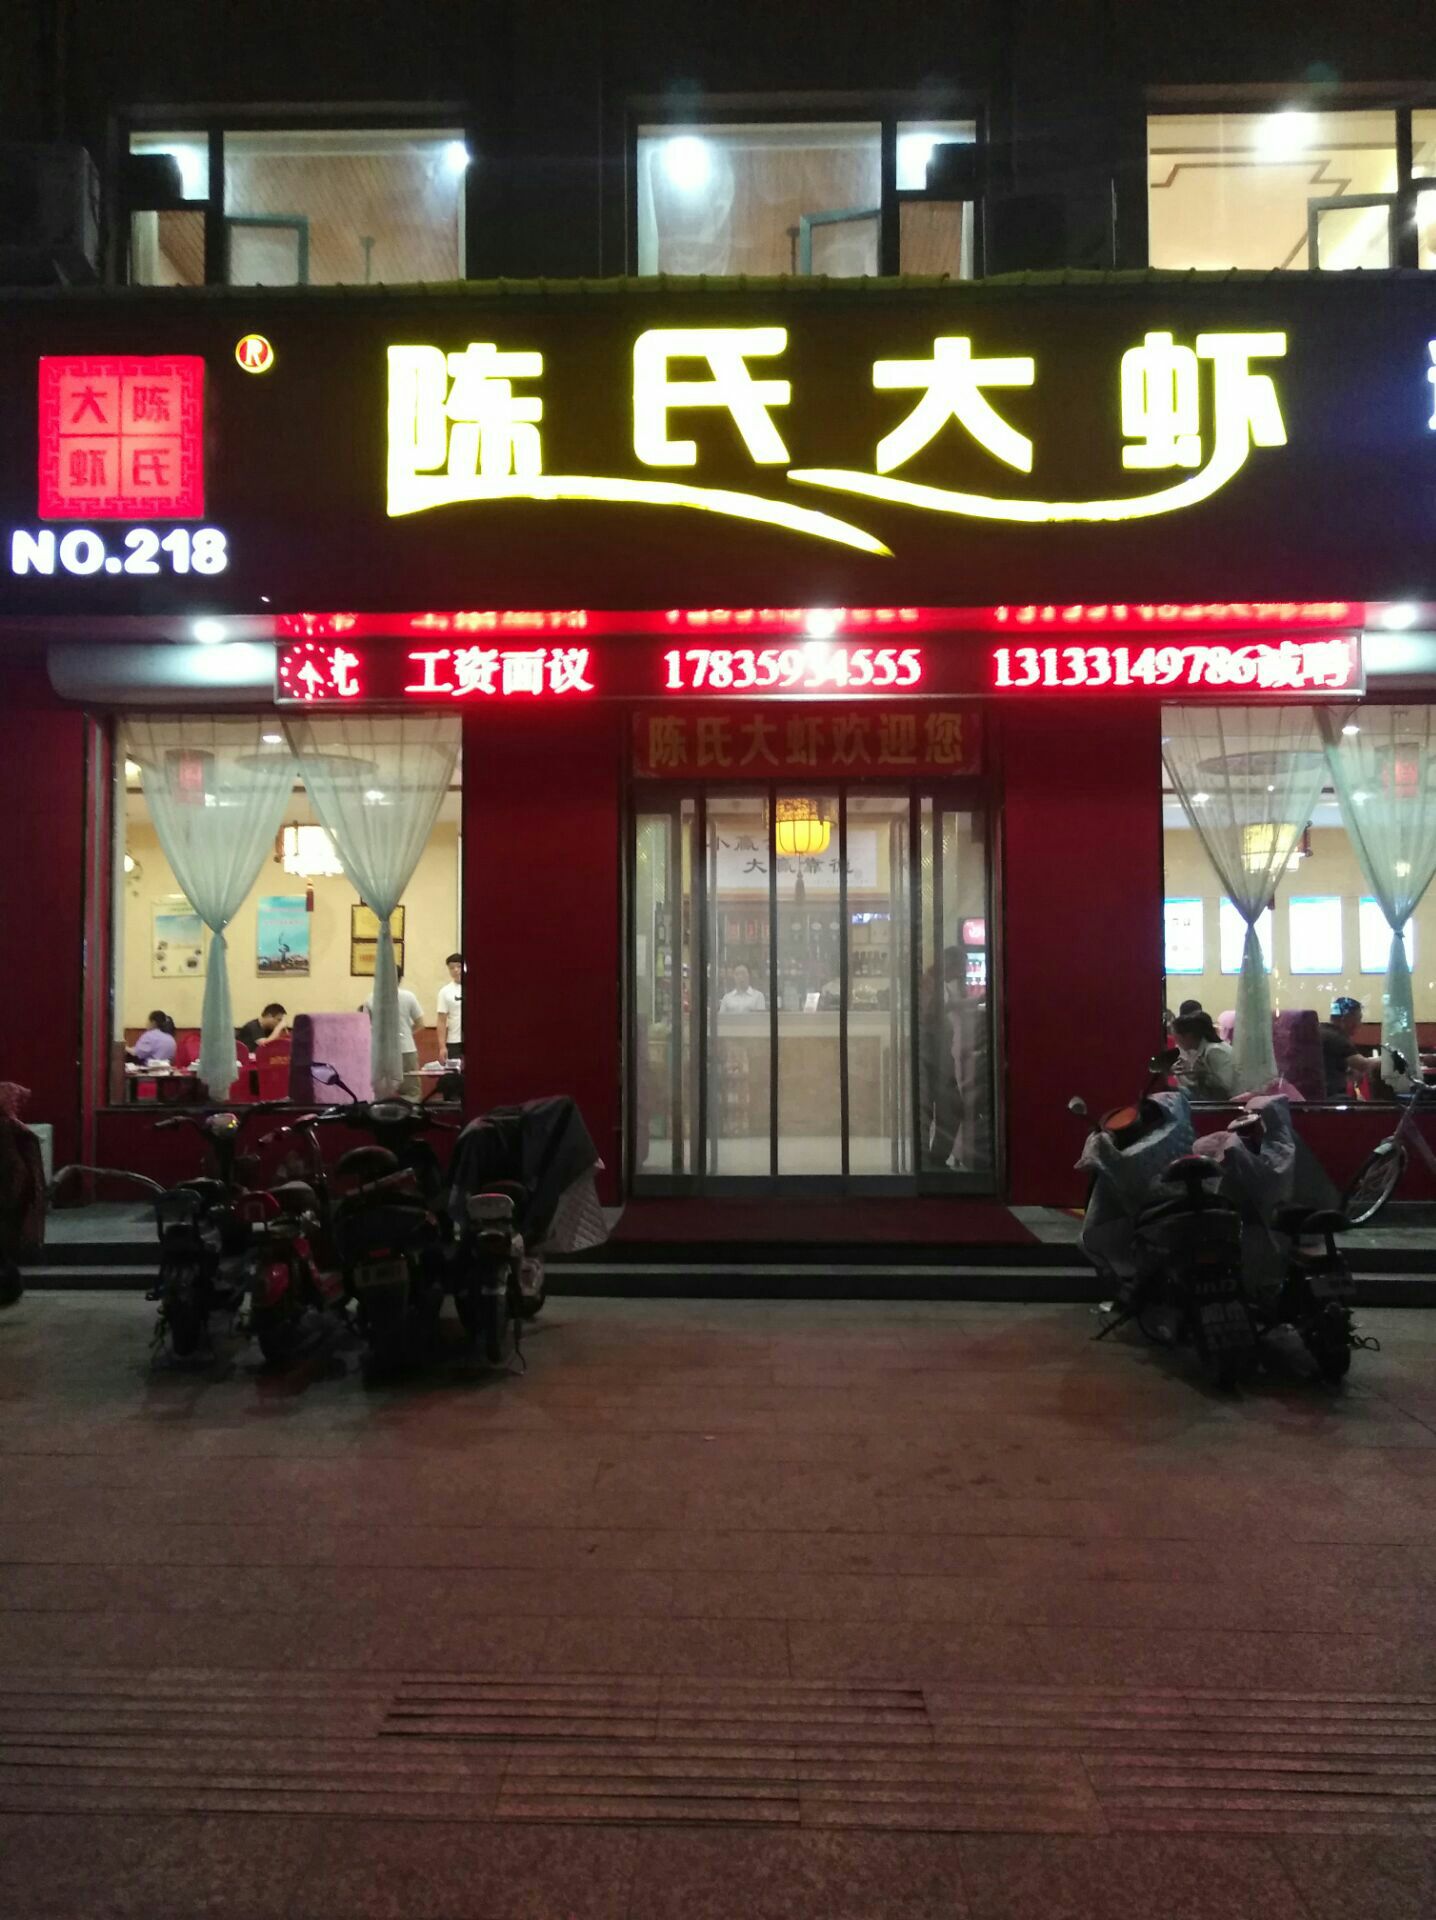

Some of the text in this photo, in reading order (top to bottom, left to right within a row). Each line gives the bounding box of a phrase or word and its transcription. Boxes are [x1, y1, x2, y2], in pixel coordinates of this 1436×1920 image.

[387, 327, 1288, 557] 陈氏大虾
[11, 527, 228, 576] NO.218
[404, 646, 595, 696] 工资面议
[649, 711, 963, 768] 陈氏大虾欢迎您
